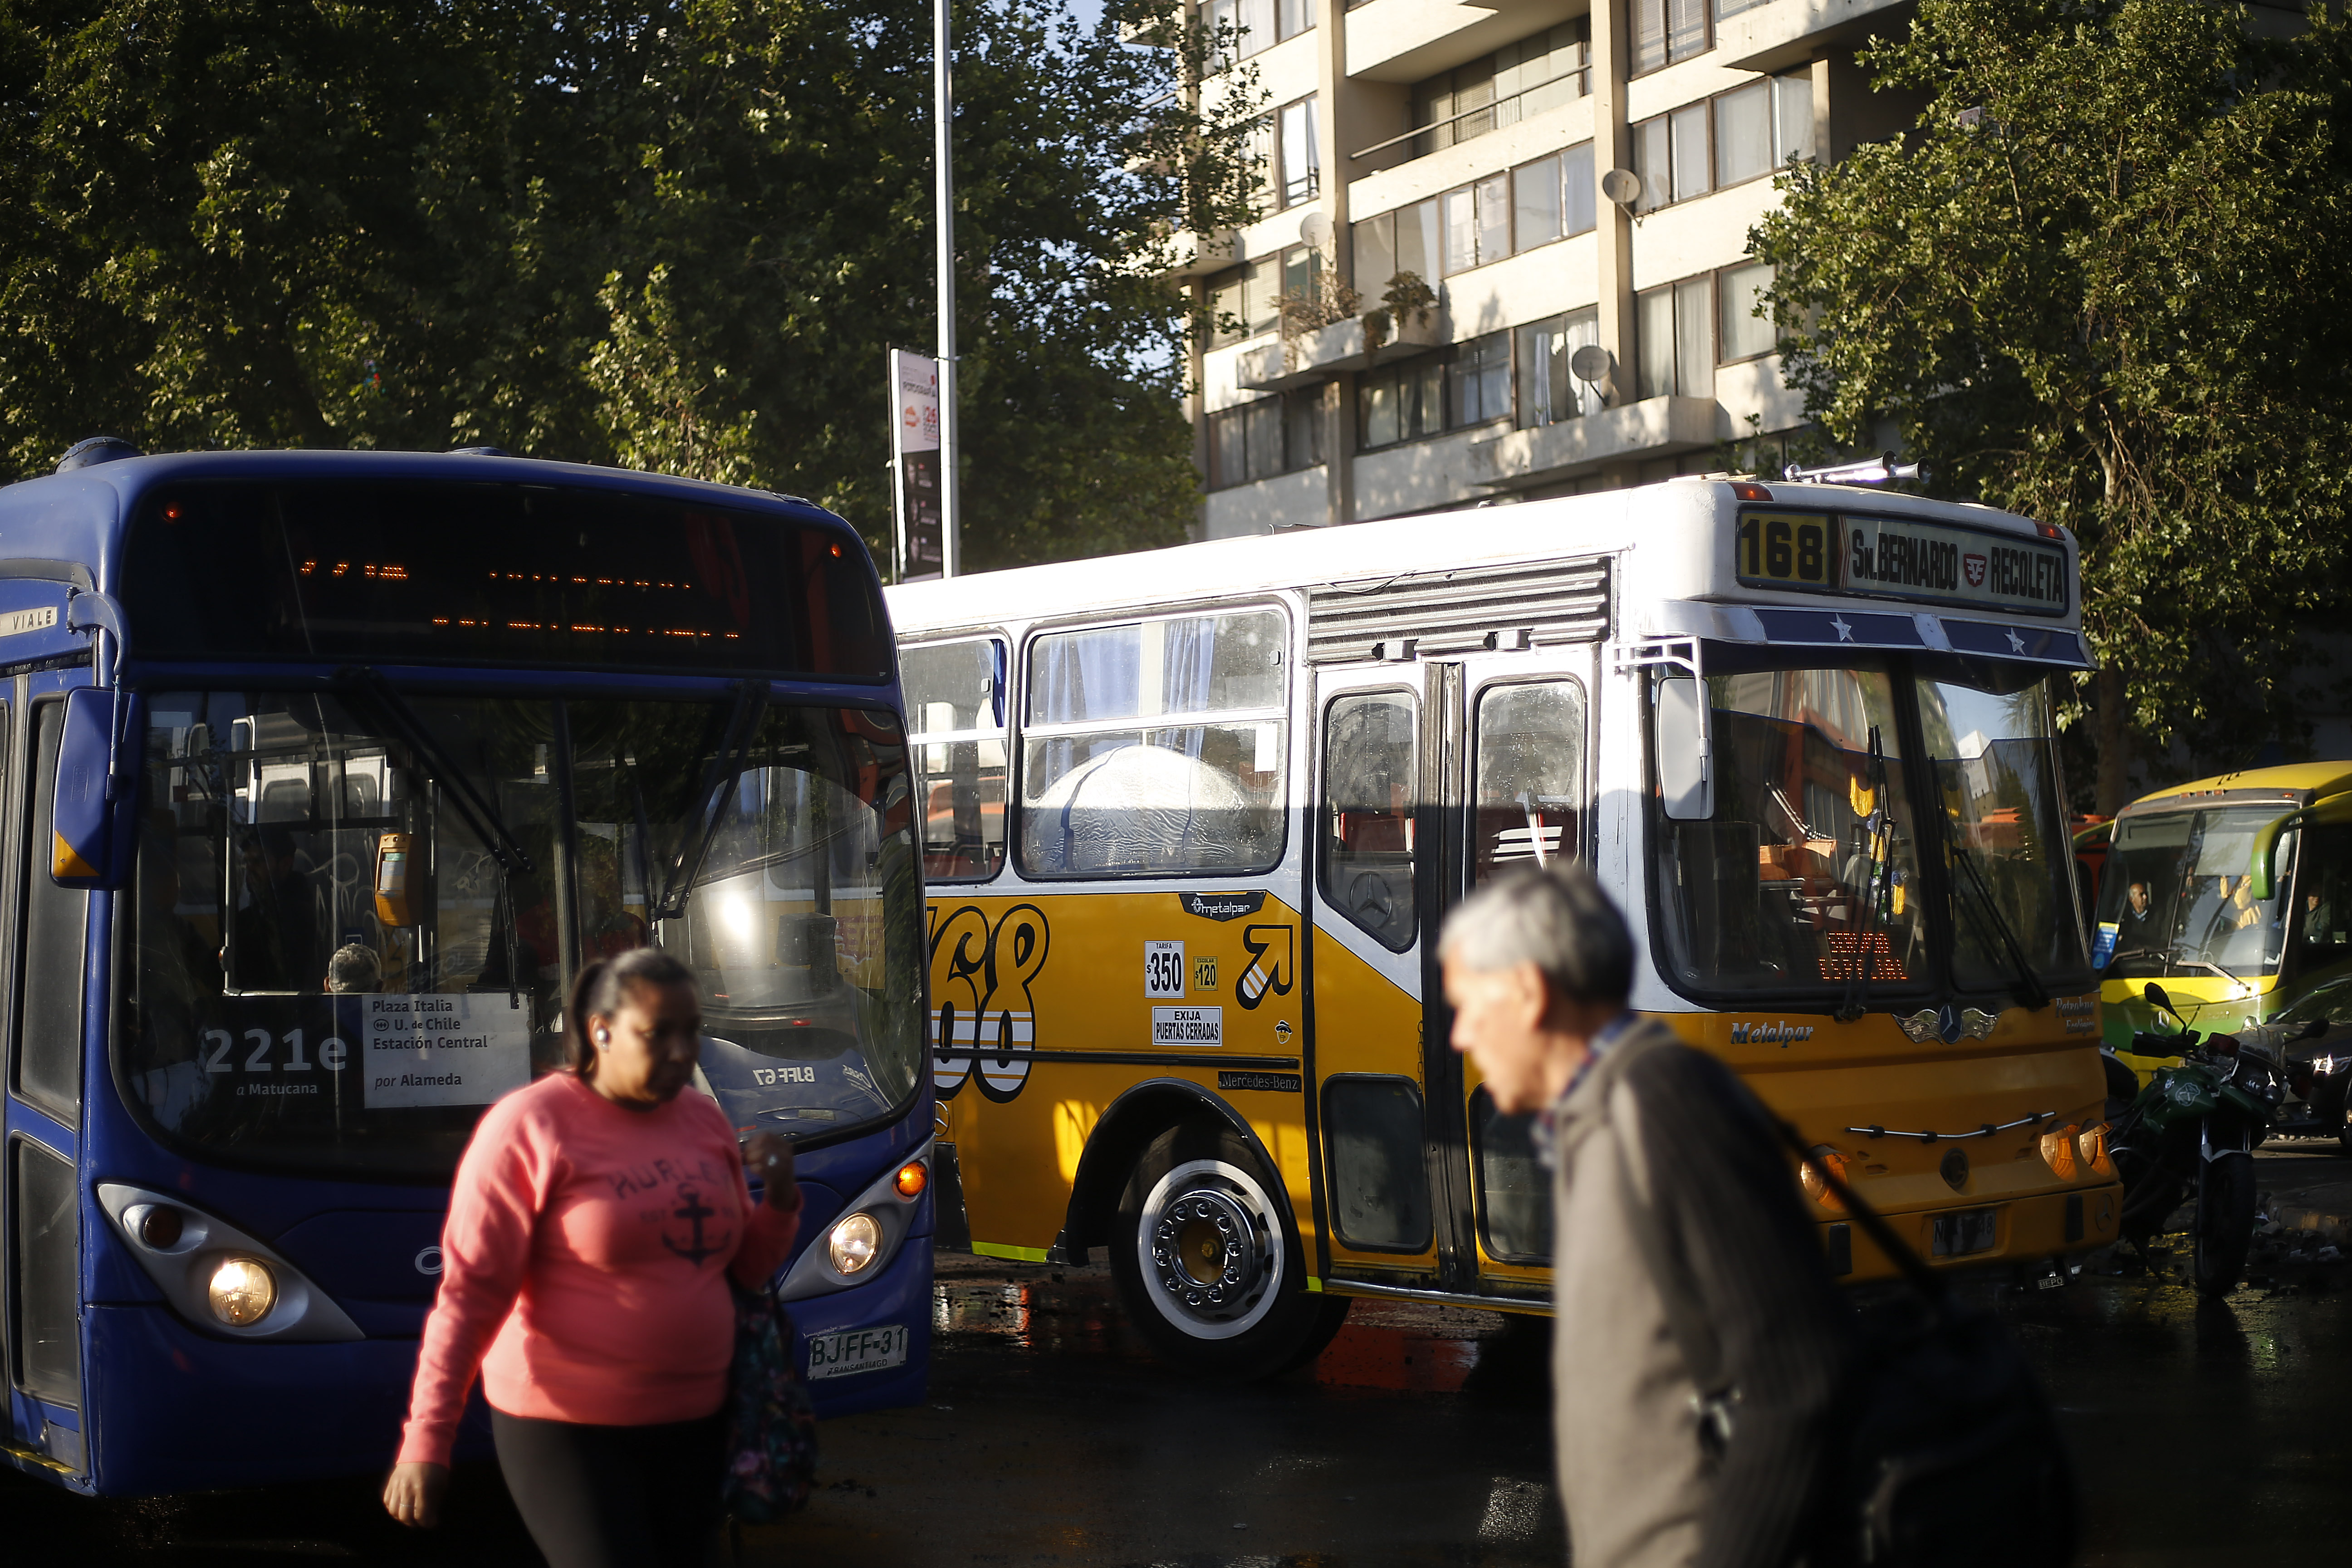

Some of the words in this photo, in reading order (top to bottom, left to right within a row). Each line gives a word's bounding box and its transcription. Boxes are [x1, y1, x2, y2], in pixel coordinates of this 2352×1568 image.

[1742, 519, 1823, 581] 168
[1991, 547, 2063, 603] RECOLETA
[13, 610, 51, 630] VIALE
[1201, 902, 1250, 916] metalpar
[372, 1000, 409, 1013] Plaza
[414, 1000, 453, 1013] Italia
[1175, 1011, 1201, 1020] EXIJA
[394, 1019, 408, 1031] U.
[412, 1019, 423, 1030] de
[426, 1018, 461, 1031] Chile
[1156, 1022, 1184, 1039] PUERTAS
[1186, 1022, 1219, 1040] CERRADAS
[1731, 1020, 1813, 1048] Metalpar
[373, 1035, 432, 1050] Estación
[437, 1035, 488, 1049] Central
[205, 1028, 347, 1073] 221e
[375, 1075, 397, 1091] por
[400, 1073, 462, 1087] Alameda
[1222, 1074, 1297, 1089] Mercedes-Benz
[236, 1085, 245, 1096] a
[249, 1083, 318, 1095] Matucana
[2040, 1278, 2063, 1287] BEPO
[829, 1358, 887, 1374] TRANSANTIAGO
